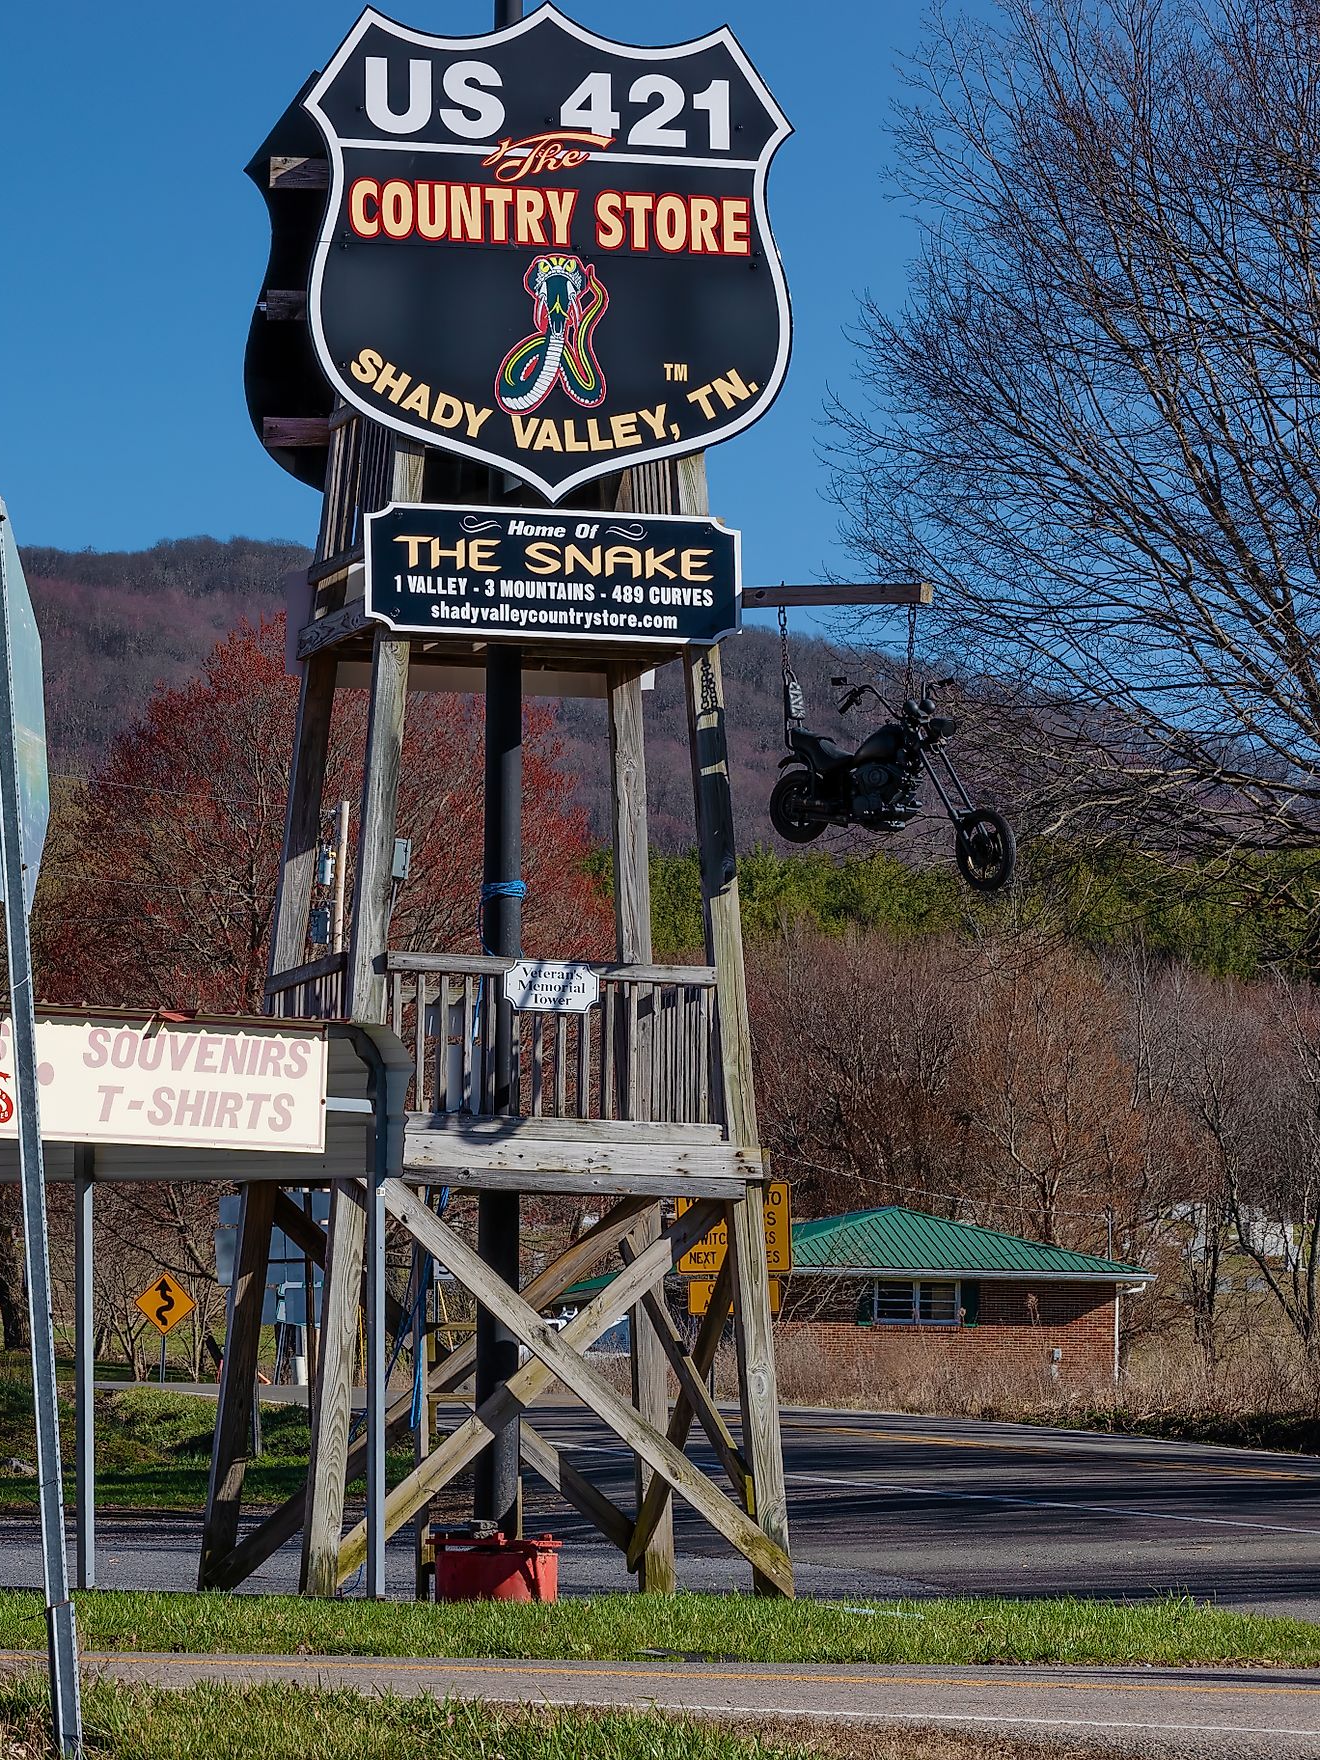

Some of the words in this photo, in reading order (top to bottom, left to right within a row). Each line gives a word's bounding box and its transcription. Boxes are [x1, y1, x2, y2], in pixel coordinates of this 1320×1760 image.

[364, 57, 506, 139] US
[560, 72, 731, 151] 421
[481, 131, 615, 183] The
[348, 176, 579, 248] COUNTRY
[595, 190, 752, 256] STORE
[663, 362, 688, 382] TM
[350, 347, 494, 440] SHADY
[511, 404, 681, 454] VALLEY,
[688, 368, 760, 421] TN.
[507, 520, 567, 539] Home
[574, 523, 601, 539] Of
[392, 535, 503, 573] THE
[524, 541, 715, 582] SNAKE
[393, 574, 402, 593] 1
[406, 575, 467, 596] VALLEY
[484, 579, 495, 597] 3
[499, 580, 595, 602] MOUNTAINS
[611, 584, 643, 603] 489
[649, 586, 714, 608] CURVES
[430, 602, 678, 630] shadyvalleycountrystore.com
[517, 979, 586, 994] Memorial
[522, 967, 583, 981] Veteran's
[531, 993, 572, 1006] Tower
[82, 1026, 311, 1080] SOUVENIRS
[97, 1084, 295, 1133] T-SHIRTS
[689, 1251, 717, 1265] NEXT
